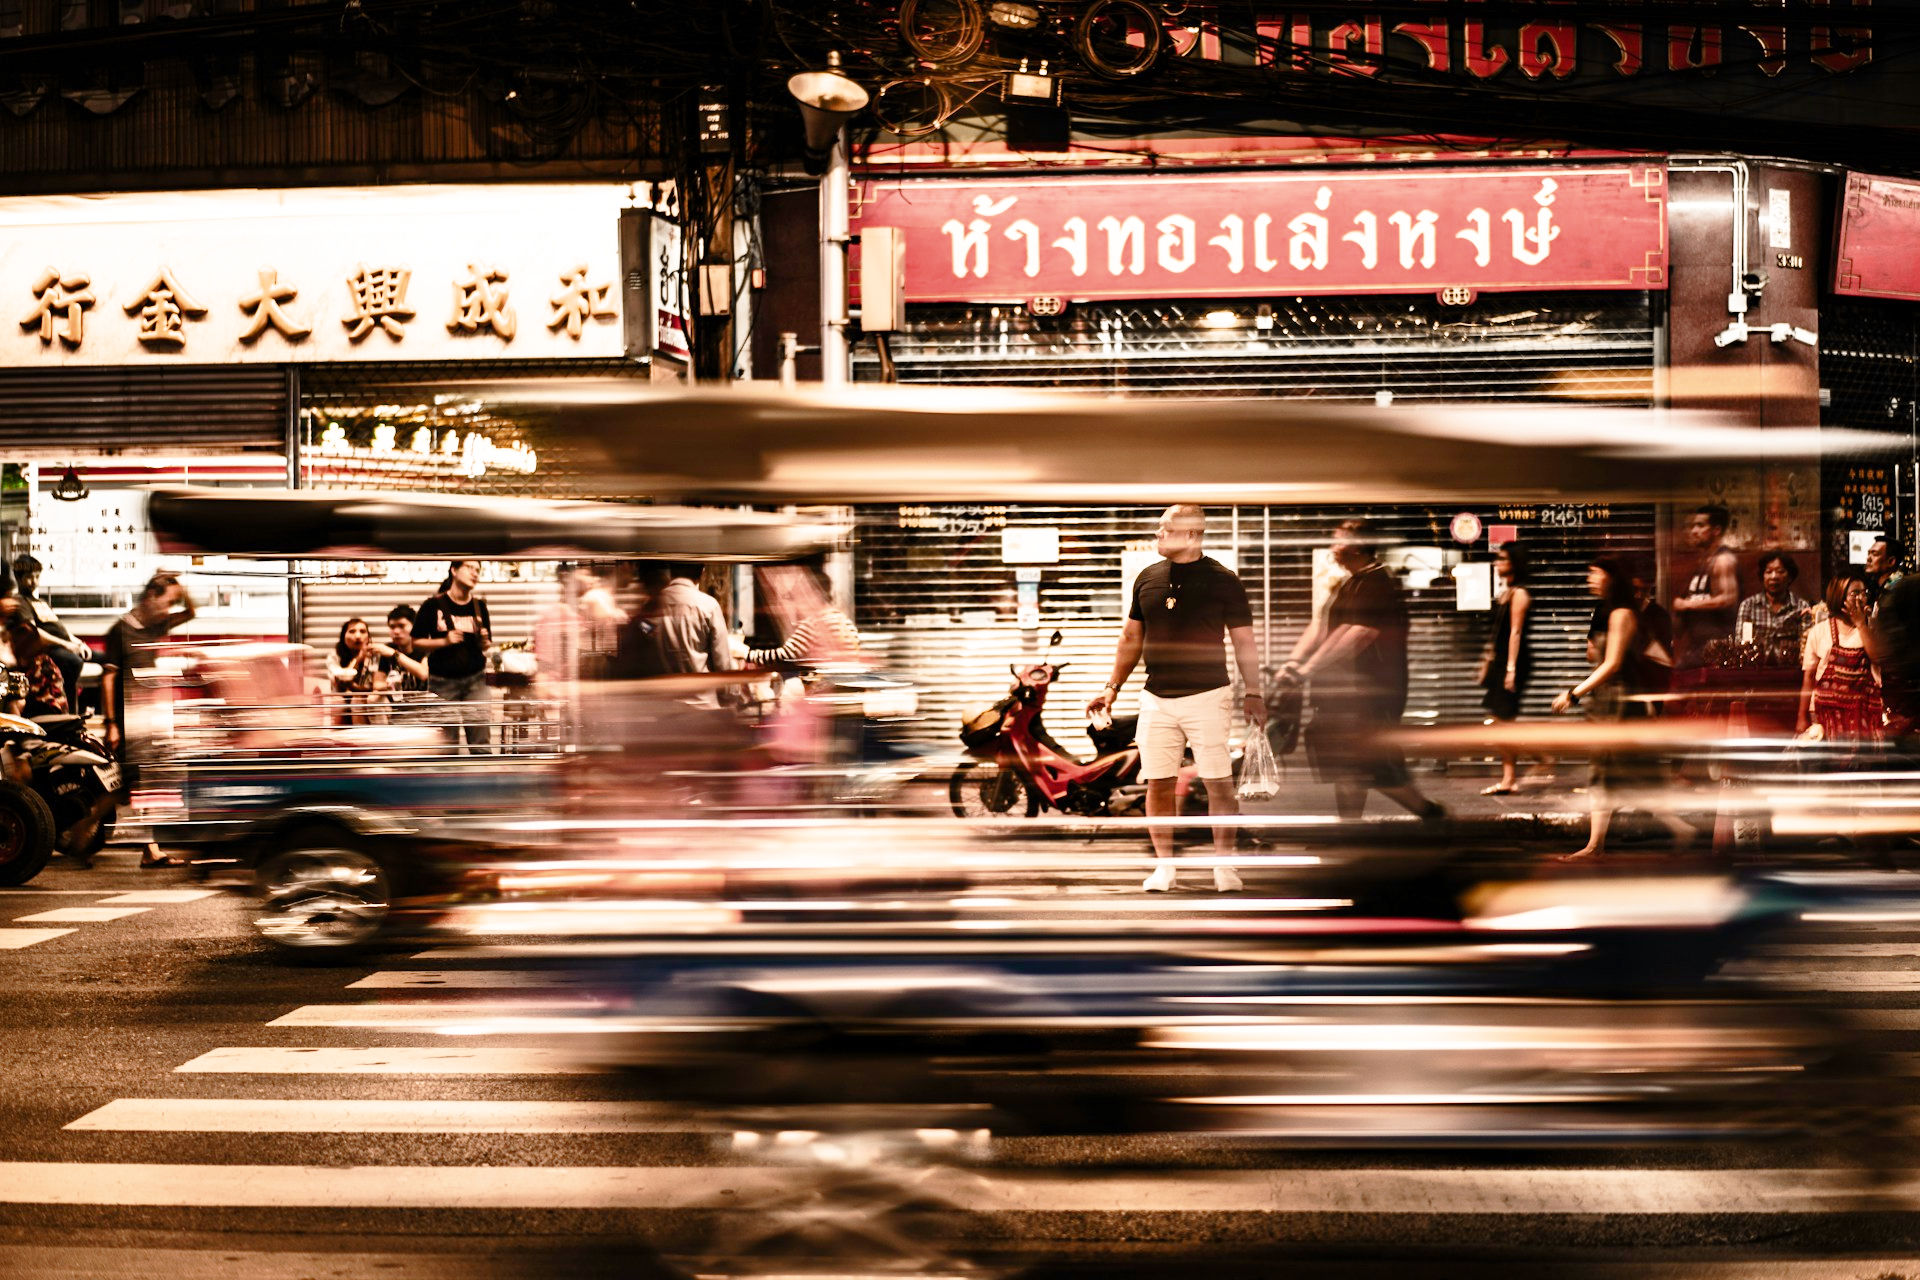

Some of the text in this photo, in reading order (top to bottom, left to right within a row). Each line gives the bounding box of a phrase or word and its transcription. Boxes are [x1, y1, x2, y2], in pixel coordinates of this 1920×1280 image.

[941, 177, 1561, 278] ห้างทองเล่งหงษ์
